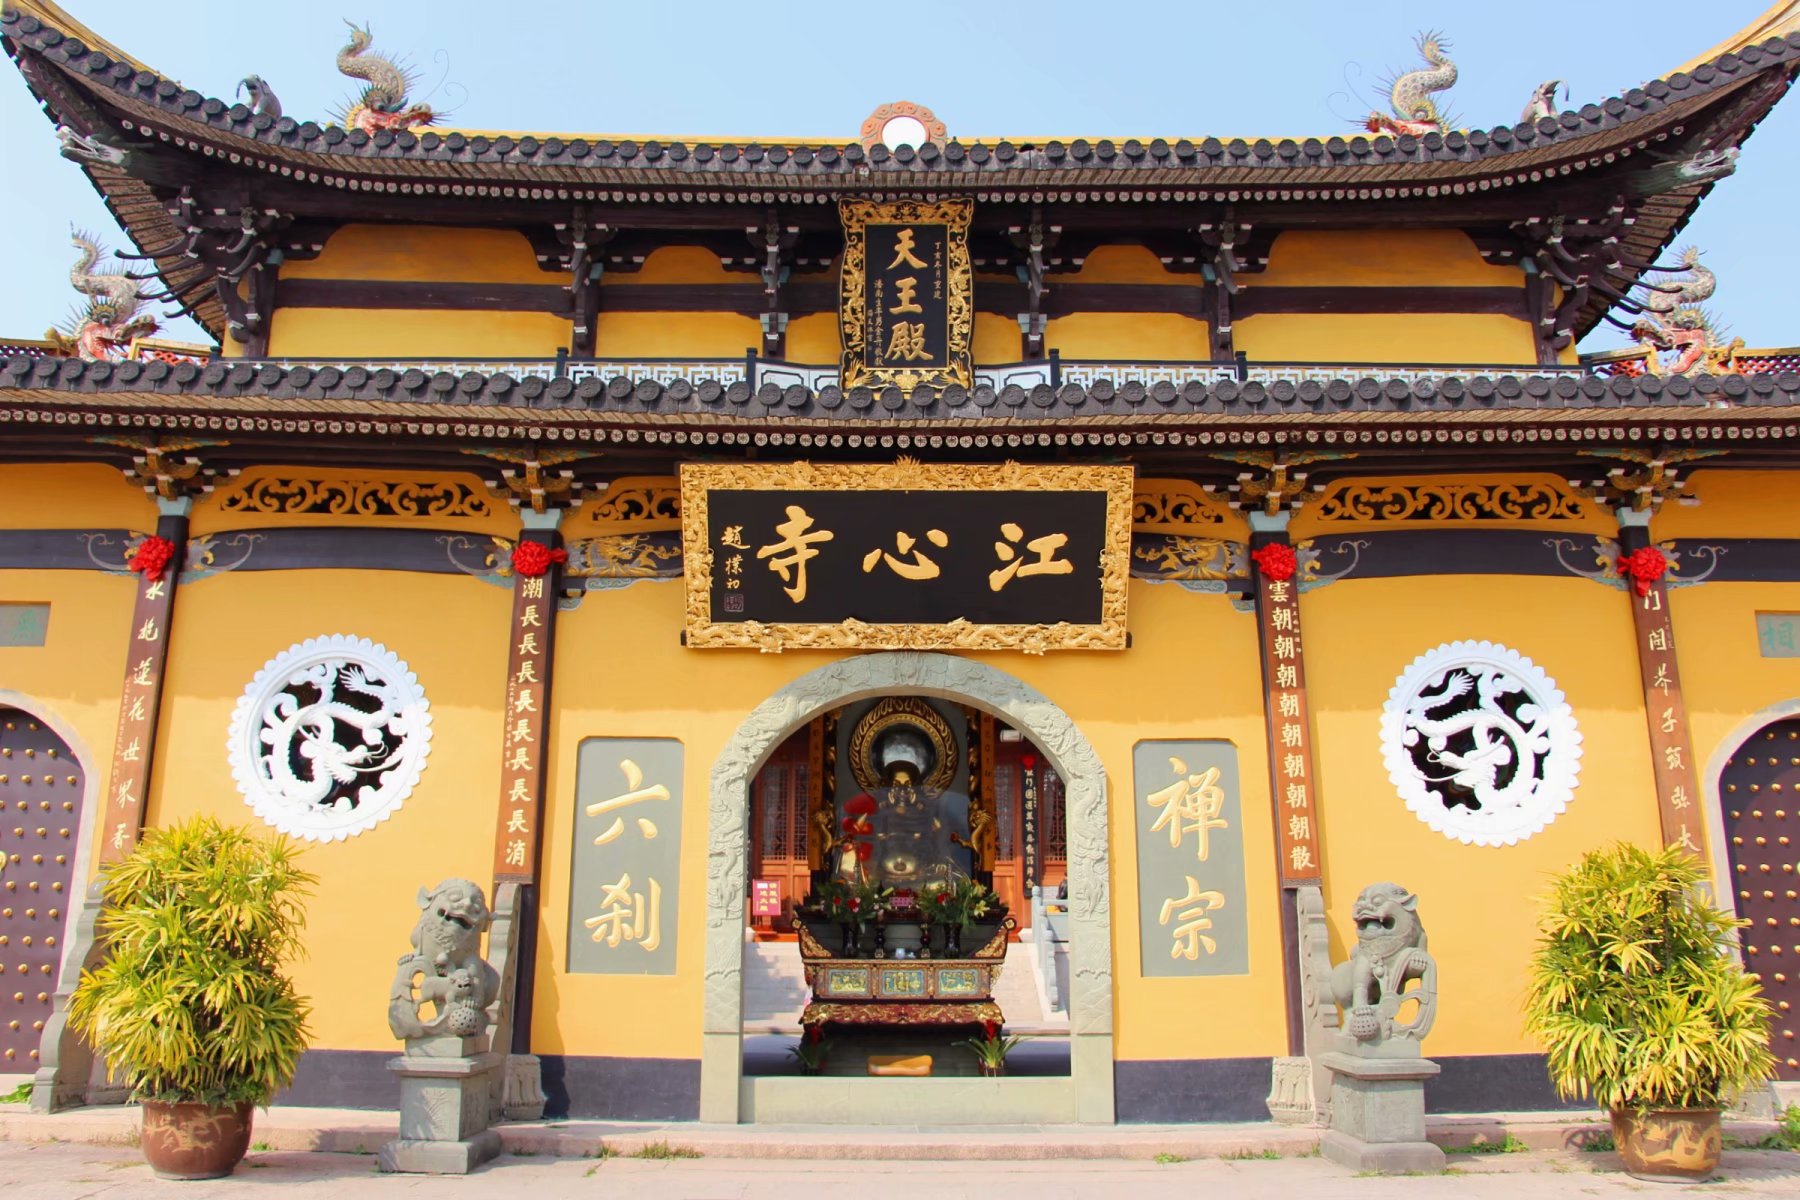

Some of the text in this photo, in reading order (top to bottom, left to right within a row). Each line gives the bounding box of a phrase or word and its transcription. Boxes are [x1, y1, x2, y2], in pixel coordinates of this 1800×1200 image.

[884, 228, 934, 361] 天王殿
[756, 505, 1074, 604] 江心寺
[1268, 579, 1316, 871] 雲朝朝朝朝朝朝朝朝散
